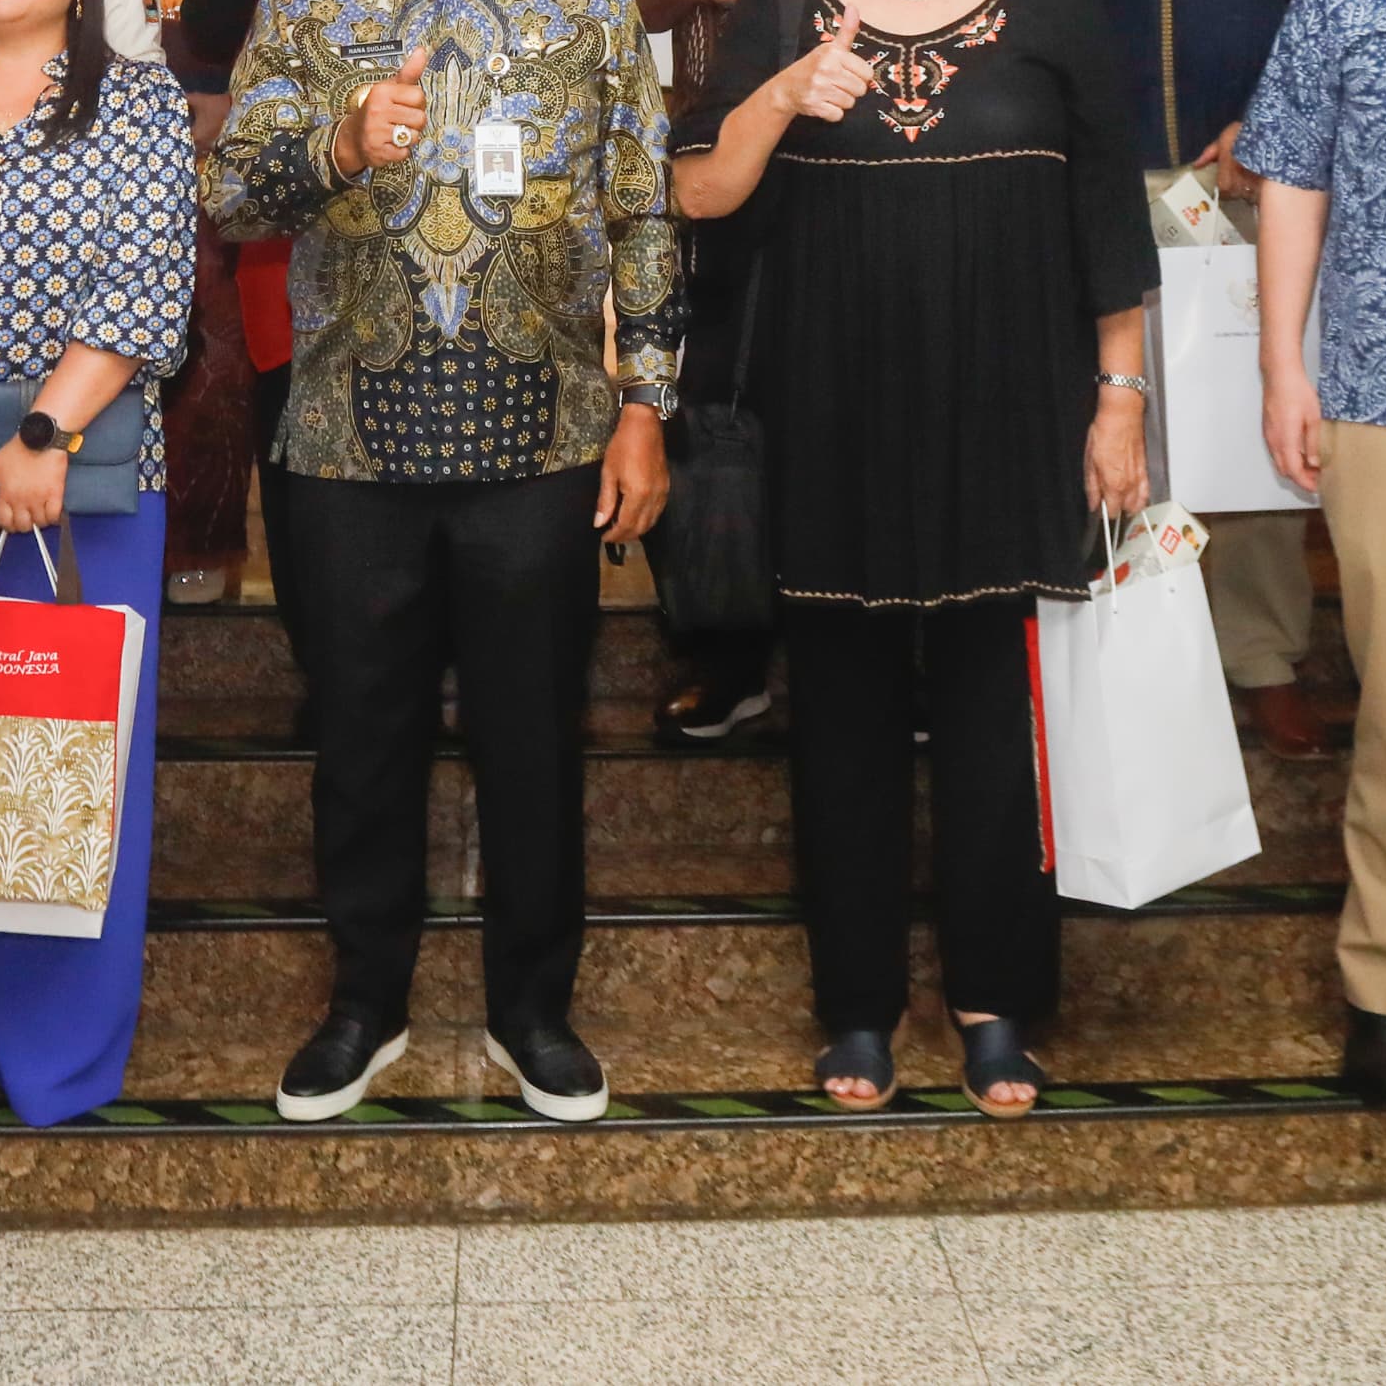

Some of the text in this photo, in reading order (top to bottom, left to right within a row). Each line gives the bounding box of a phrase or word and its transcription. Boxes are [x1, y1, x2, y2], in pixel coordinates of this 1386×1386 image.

[348, 44, 395, 55] NANA SUDJANA
[25, 650, 59, 663] Java
